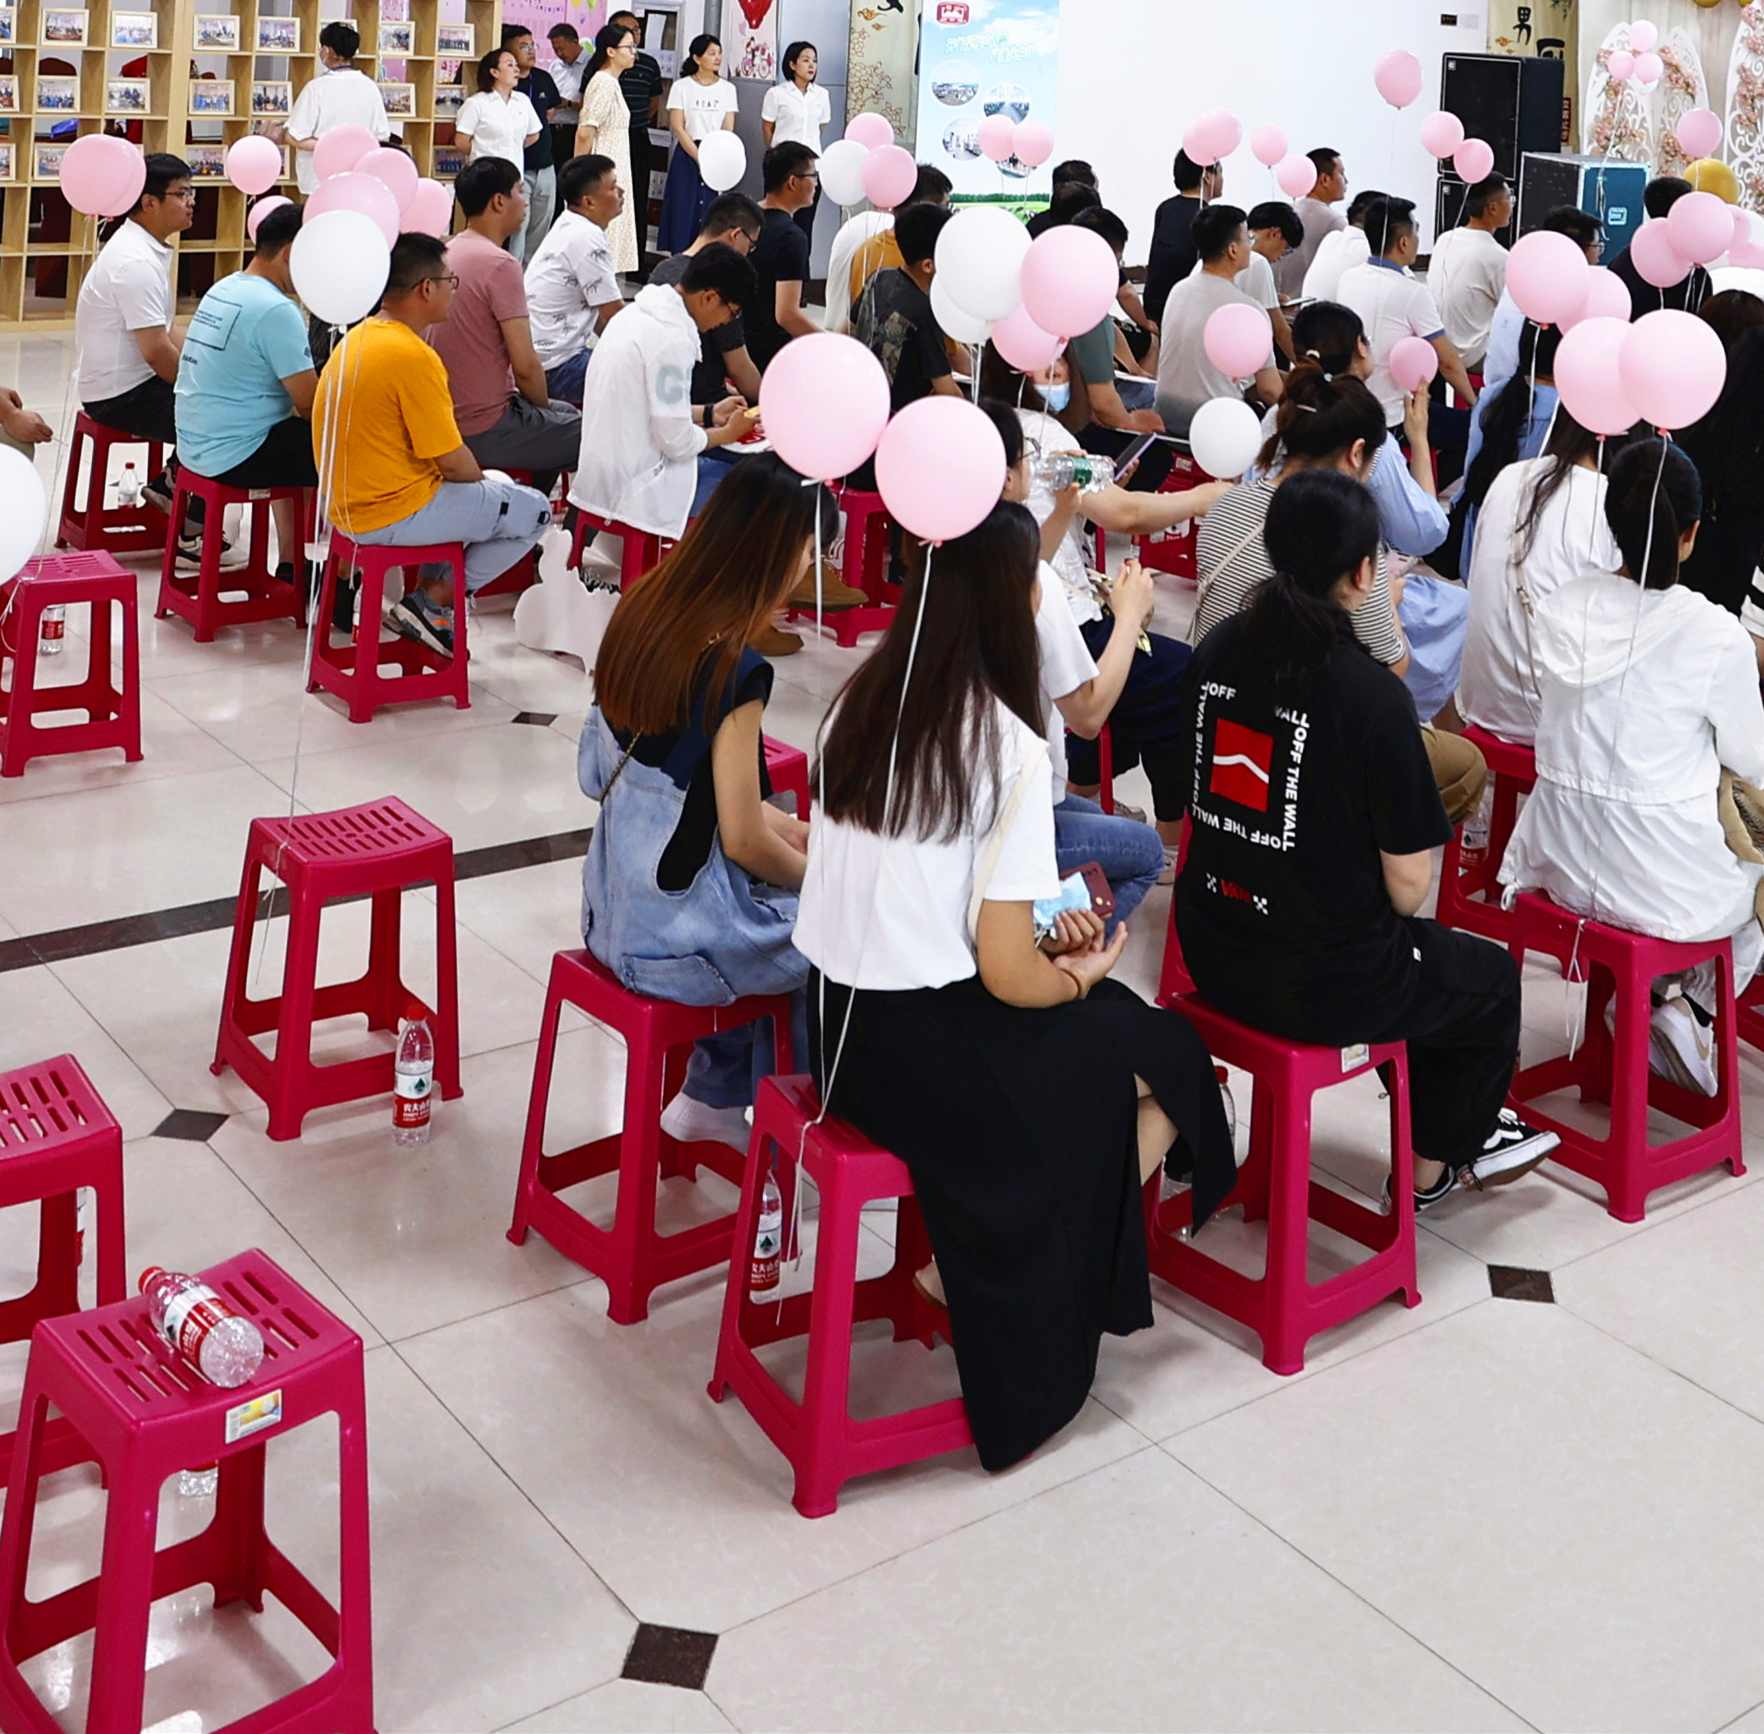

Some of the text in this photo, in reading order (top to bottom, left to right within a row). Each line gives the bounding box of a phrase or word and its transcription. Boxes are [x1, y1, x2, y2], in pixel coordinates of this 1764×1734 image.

[1195, 681, 1210, 729] WALL
[1208, 682, 1237, 701] OFF
[1195, 730, 1204, 766] THE
[1281, 726, 1308, 852] OFF THE WALL
[1192, 802, 1282, 850] OFF THE WALL
